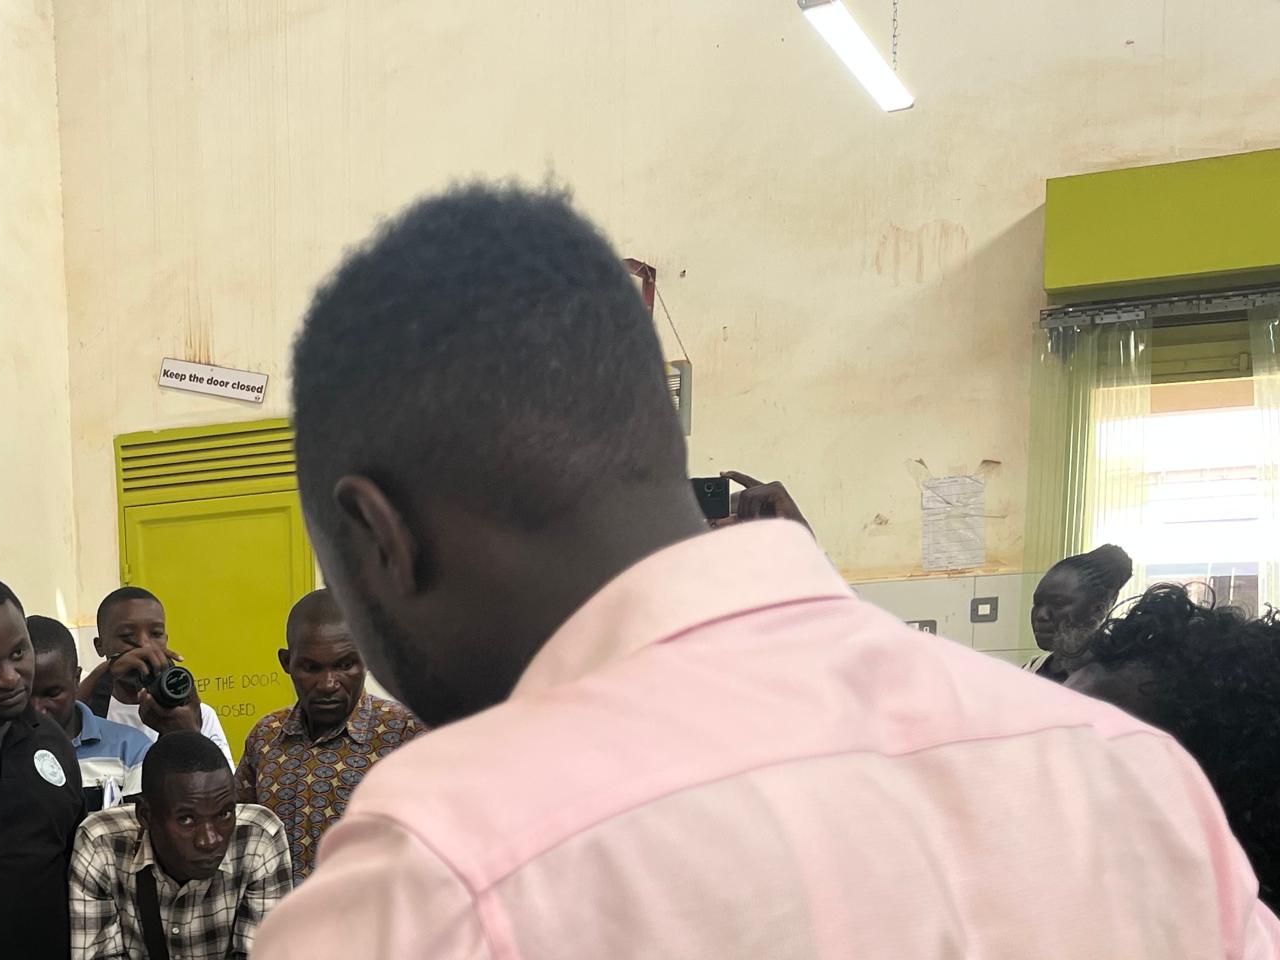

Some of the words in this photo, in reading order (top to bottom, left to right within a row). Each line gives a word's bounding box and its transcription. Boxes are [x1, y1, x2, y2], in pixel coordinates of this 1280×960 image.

[162, 368, 187, 382] Keep
[188, 373, 205, 384] the
[206, 377, 230, 388] door
[231, 381, 264, 394] closed
[215, 675, 235, 691] THE
[241, 671, 281, 689] DOOR
[216, 702, 256, 718] LOSED
